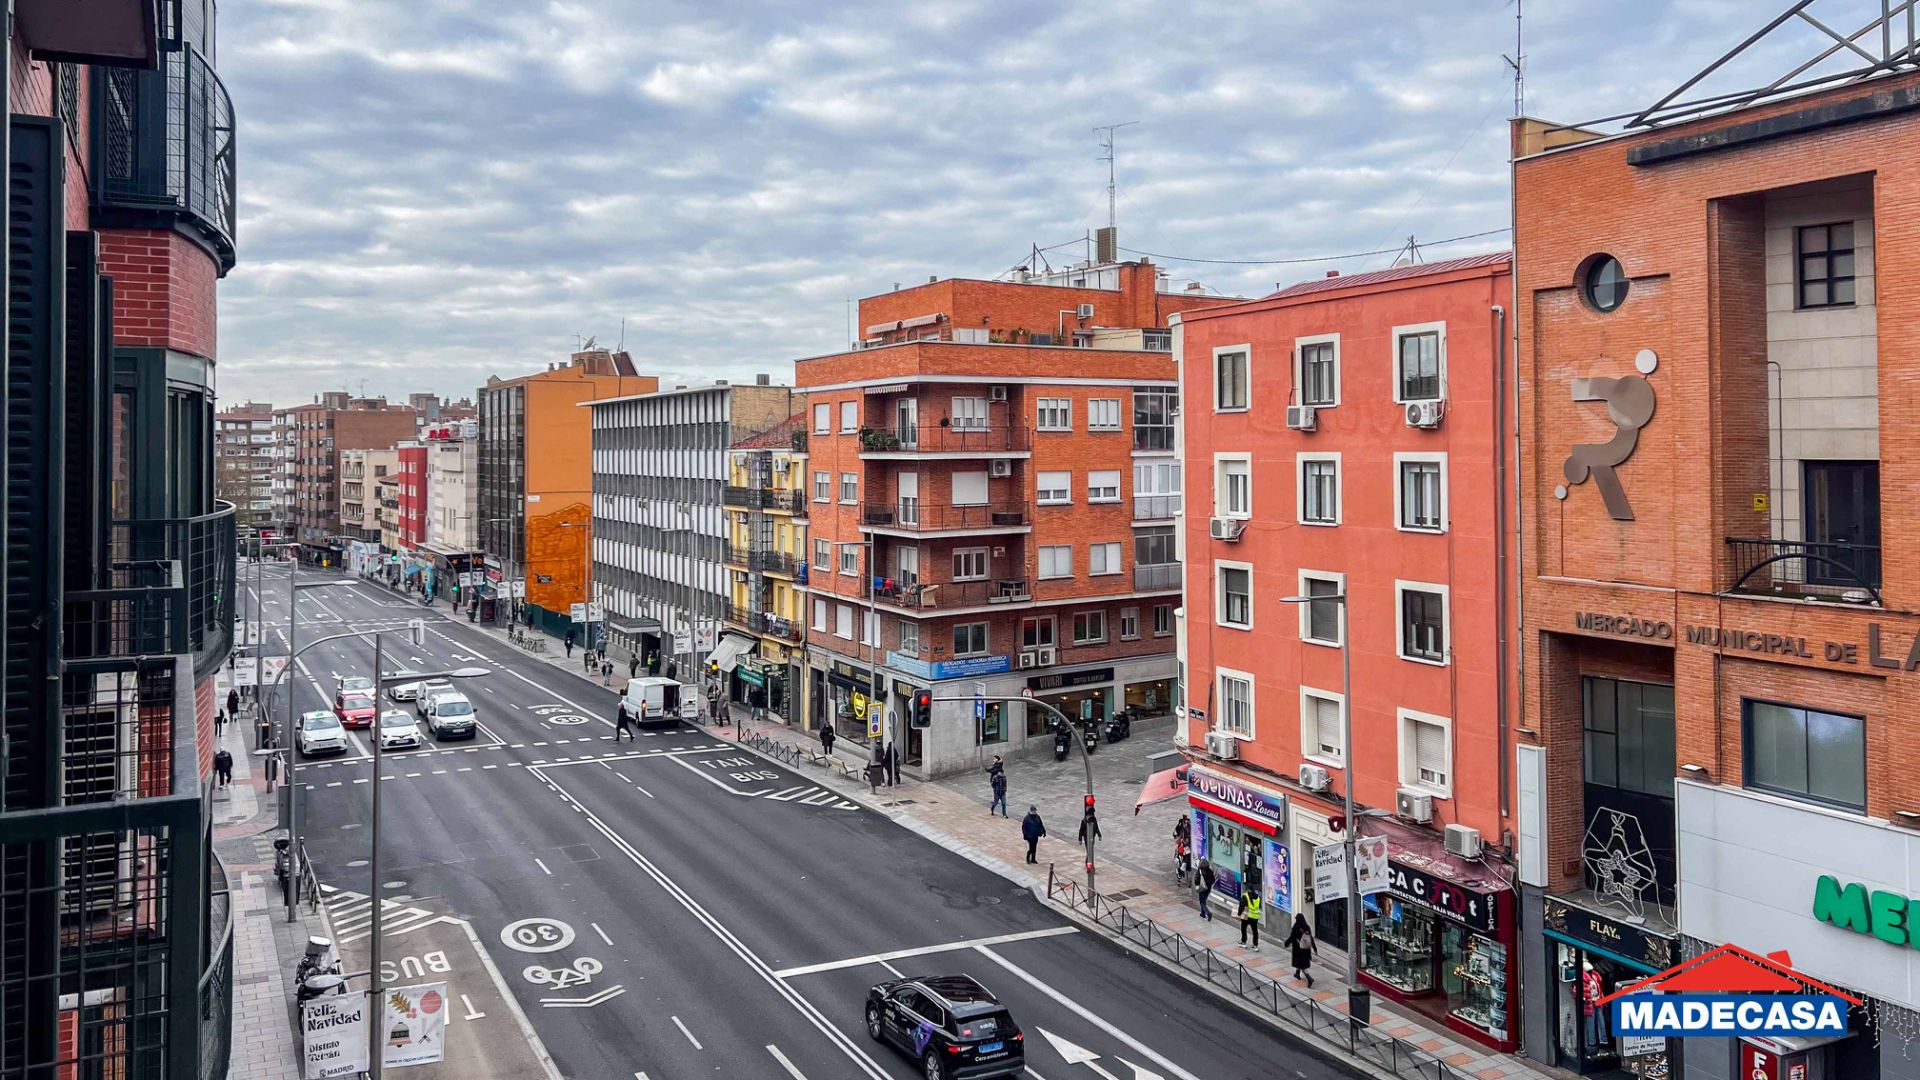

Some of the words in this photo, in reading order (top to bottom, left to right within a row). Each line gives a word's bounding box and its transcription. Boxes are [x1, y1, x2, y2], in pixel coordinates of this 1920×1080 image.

[1575, 612, 1672, 639] MERCADO
[1686, 625, 1813, 658] MUNICIPAL
[1825, 641, 1857, 664] DE
[699, 757, 755, 769] TAXI
[729, 770, 779, 782] BUS
[1217, 782, 1253, 809] UÑAS
[1487, 894, 1495, 930] ÓPTICA
[517, 925, 558, 944] 30
[380, 950, 452, 983] BUS
[307, 1003, 337, 1019] Feliz
[307, 1010, 362, 1032] Navidad
[309, 1040, 340, 1053] Distrito
[327, 1064, 354, 1075] MADRID
